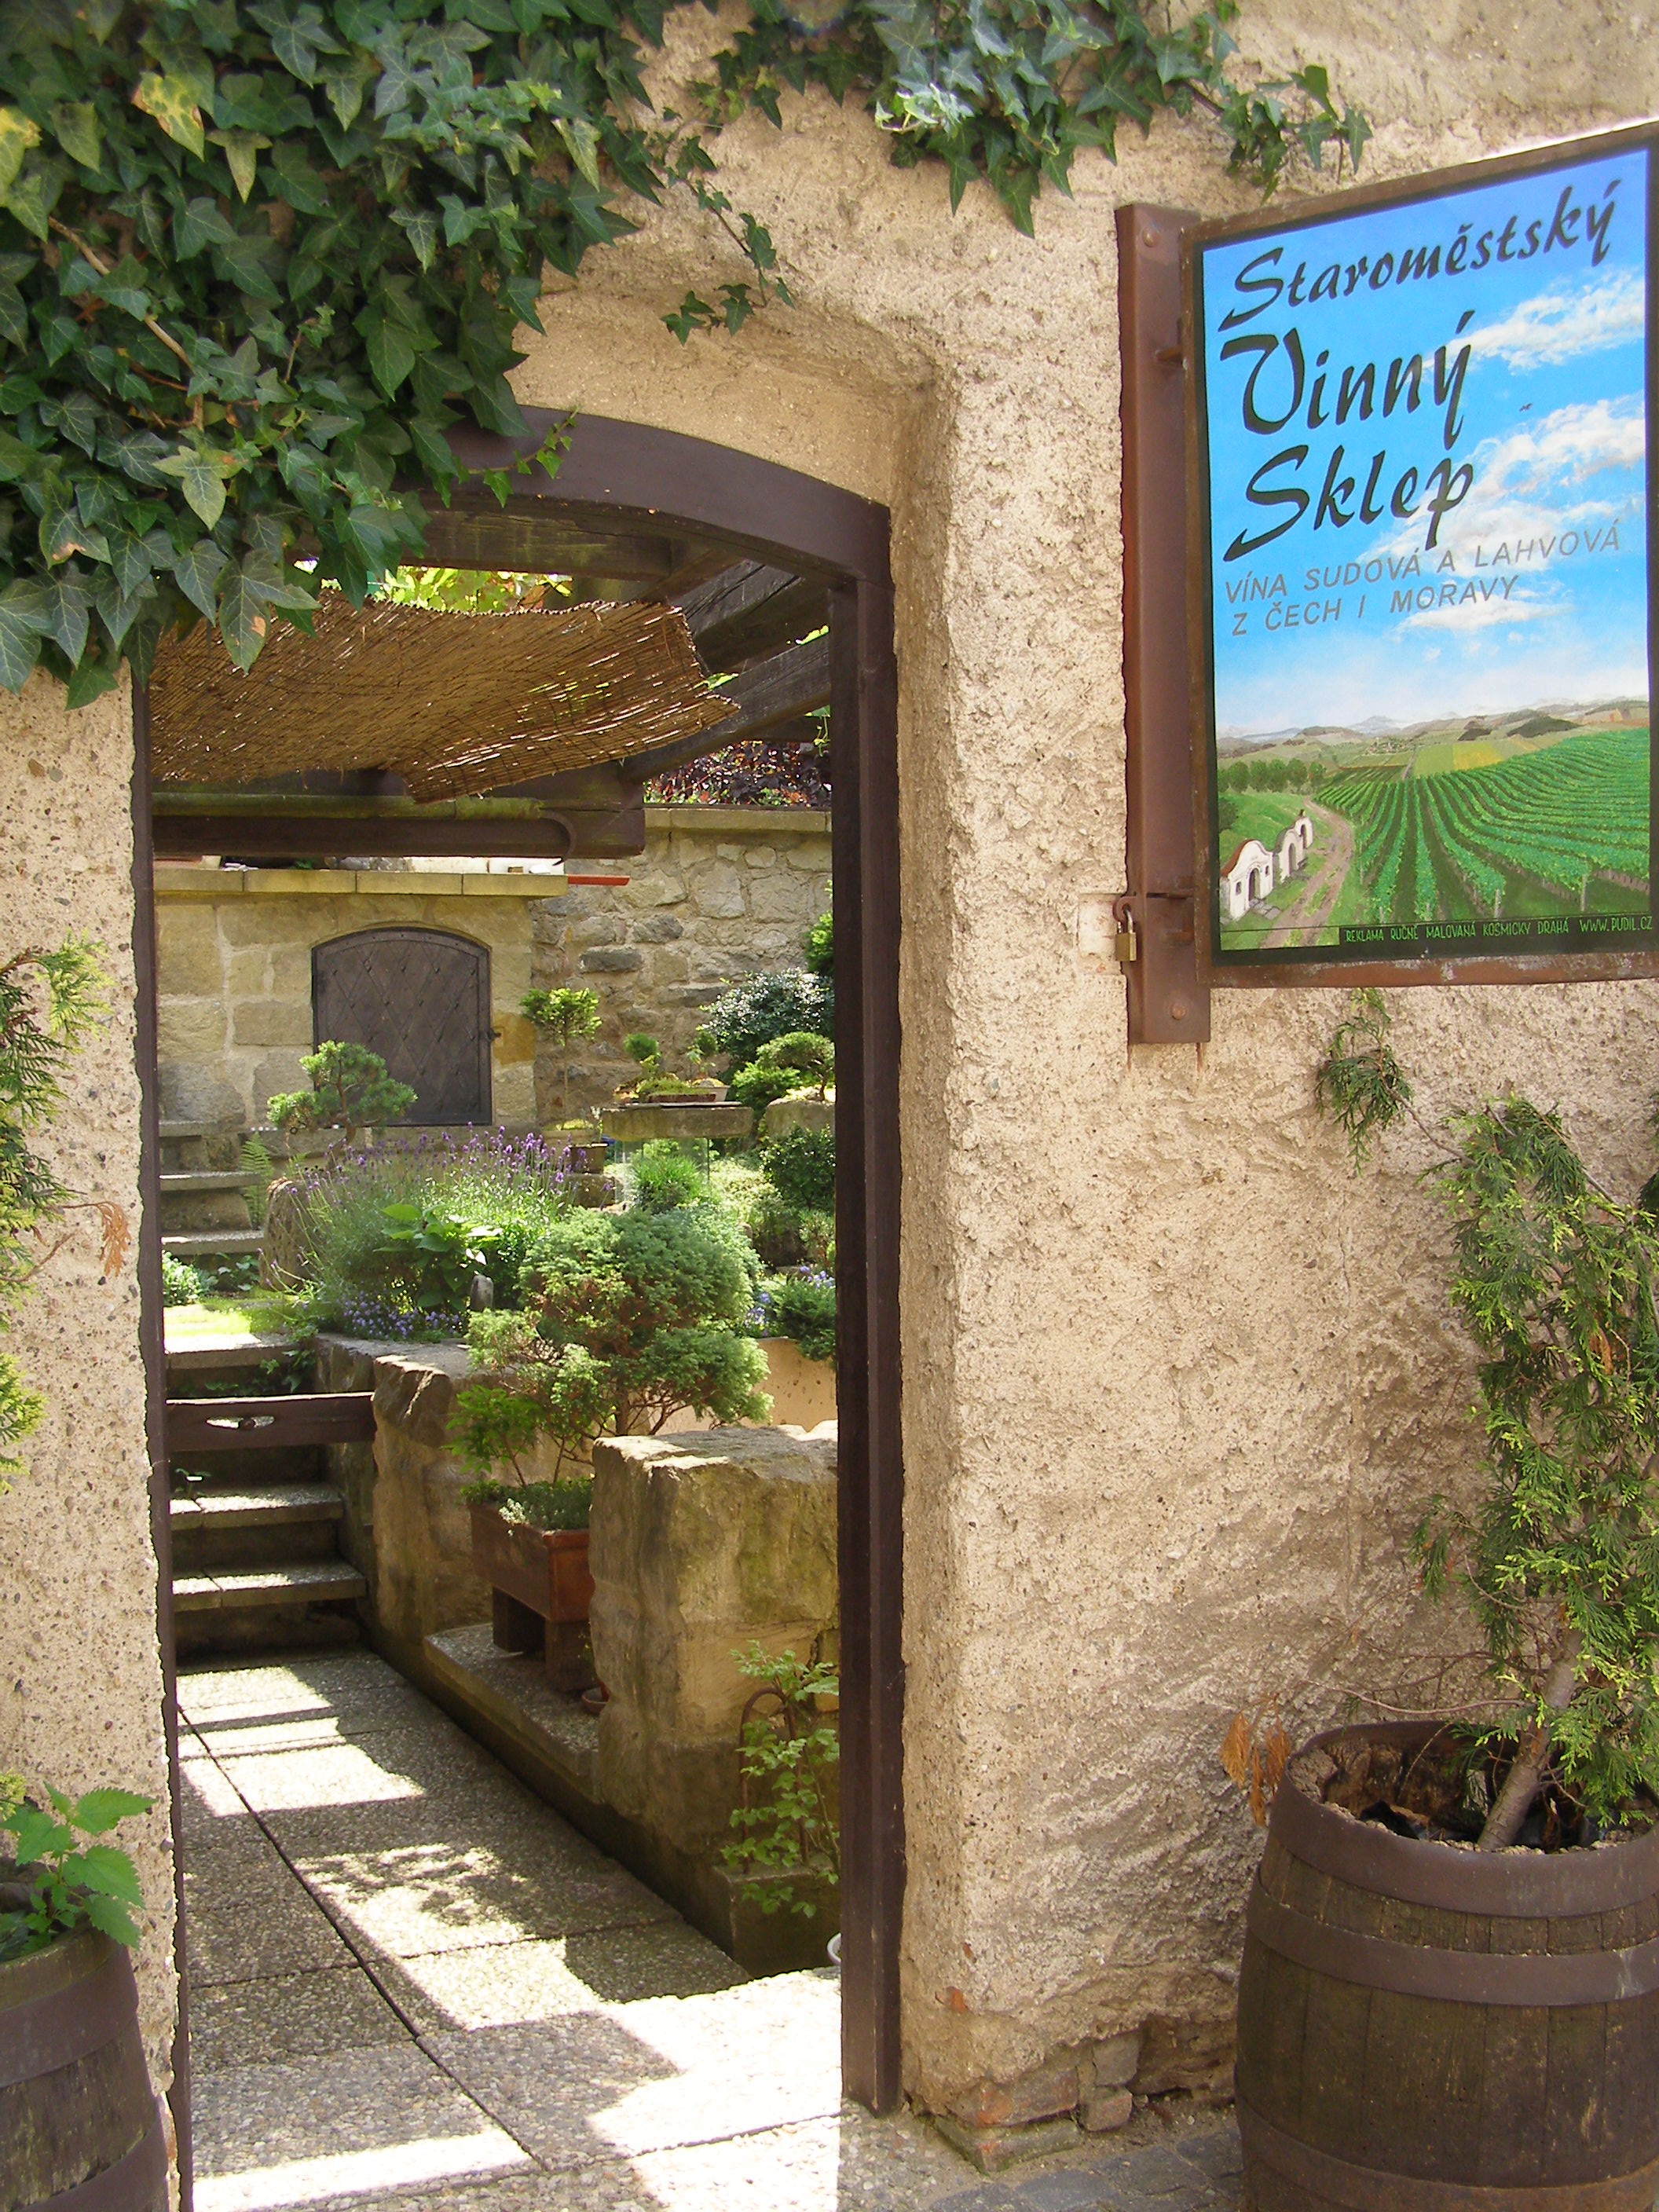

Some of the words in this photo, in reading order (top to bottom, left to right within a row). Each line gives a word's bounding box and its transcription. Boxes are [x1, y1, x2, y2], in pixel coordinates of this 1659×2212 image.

[1218, 179, 1621, 332] Staroměstský
[1220, 310, 1475, 450] Vinný
[1222, 445, 1474, 562] Sklep
[1225, 571, 1287, 604] VÍNA
[1305, 547, 1421, 591] SUDOVÁ
[1437, 550, 1456, 573] A
[1474, 518, 1621, 568] LAHVOVÁ
[1232, 613, 1247, 635] Z
[1265, 597, 1342, 631] ČECH
[1357, 595, 1366, 618] I
[1390, 574, 1520, 613] MORAVY
[1346, 928, 1384, 943] REKLAMA
[1390, 925, 1419, 940] RUČNĚ
[1426, 921, 1477, 938] MALOVANÁ
[1537, 917, 1569, 935] DRAHÁ
